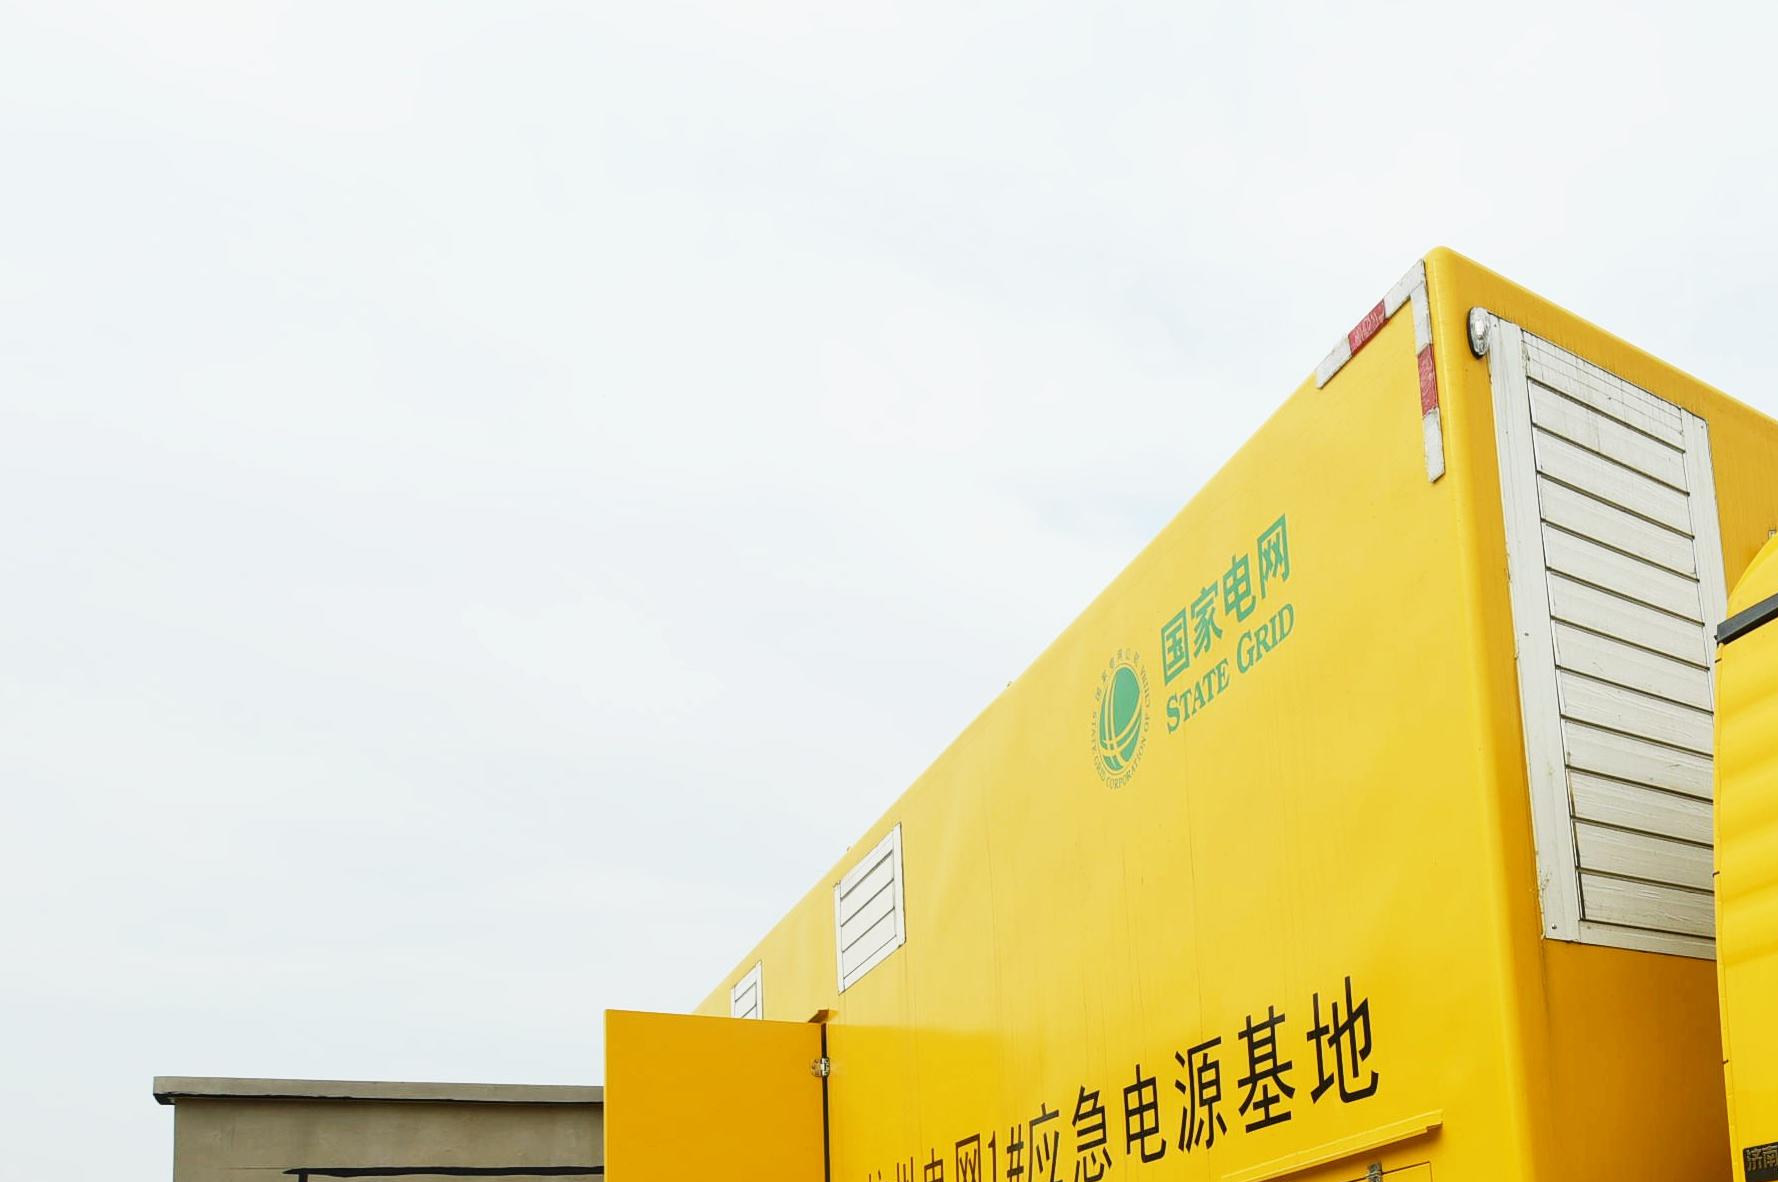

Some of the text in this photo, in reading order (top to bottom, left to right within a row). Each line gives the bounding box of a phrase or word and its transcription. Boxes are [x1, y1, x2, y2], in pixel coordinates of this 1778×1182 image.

[1160, 513, 1290, 686] 国家电网
[1166, 658, 1231, 734] STATE
[1236, 603, 1295, 674] GRID
